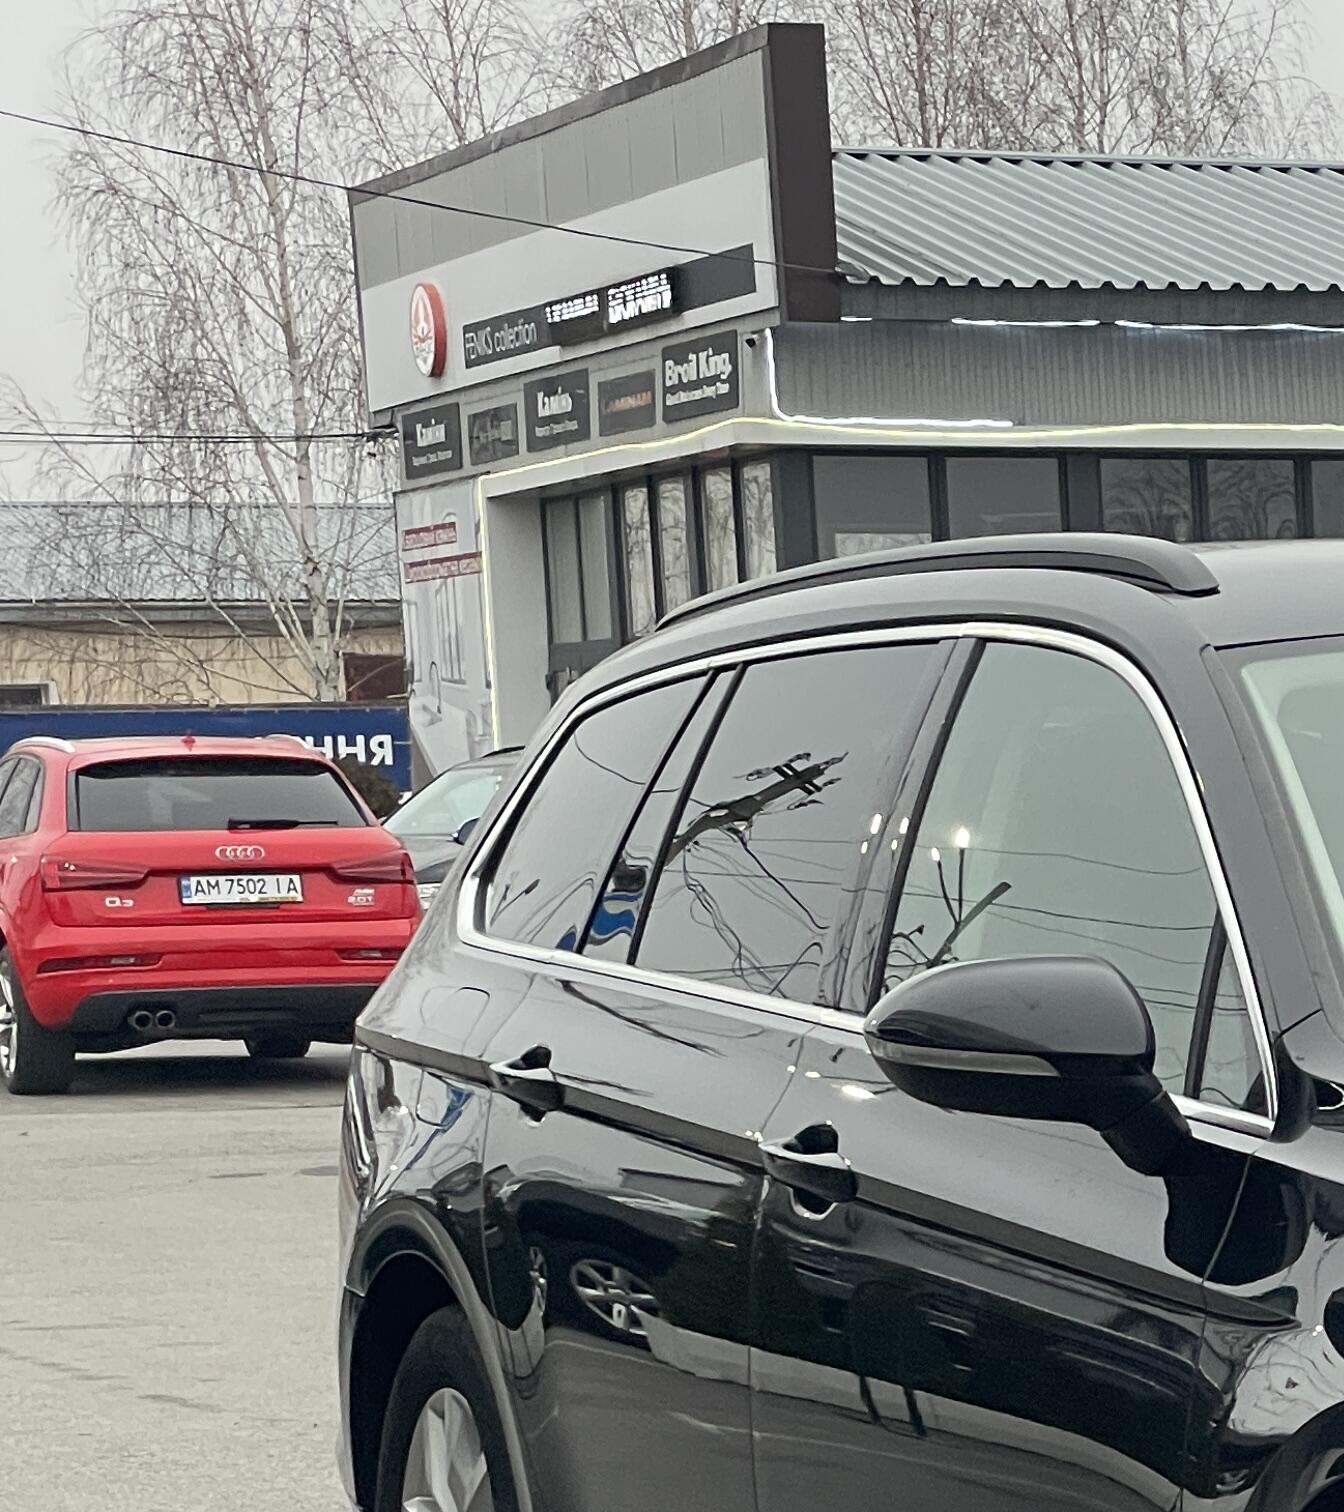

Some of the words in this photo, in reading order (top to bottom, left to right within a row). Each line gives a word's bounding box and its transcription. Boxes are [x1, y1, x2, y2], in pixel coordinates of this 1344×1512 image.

[665, 352, 698, 387] Broil
[698, 347, 732, 379] King
[194, 879, 221, 896] AM
[225, 878, 267, 895] 7502
[105, 896, 134, 908] Q3
